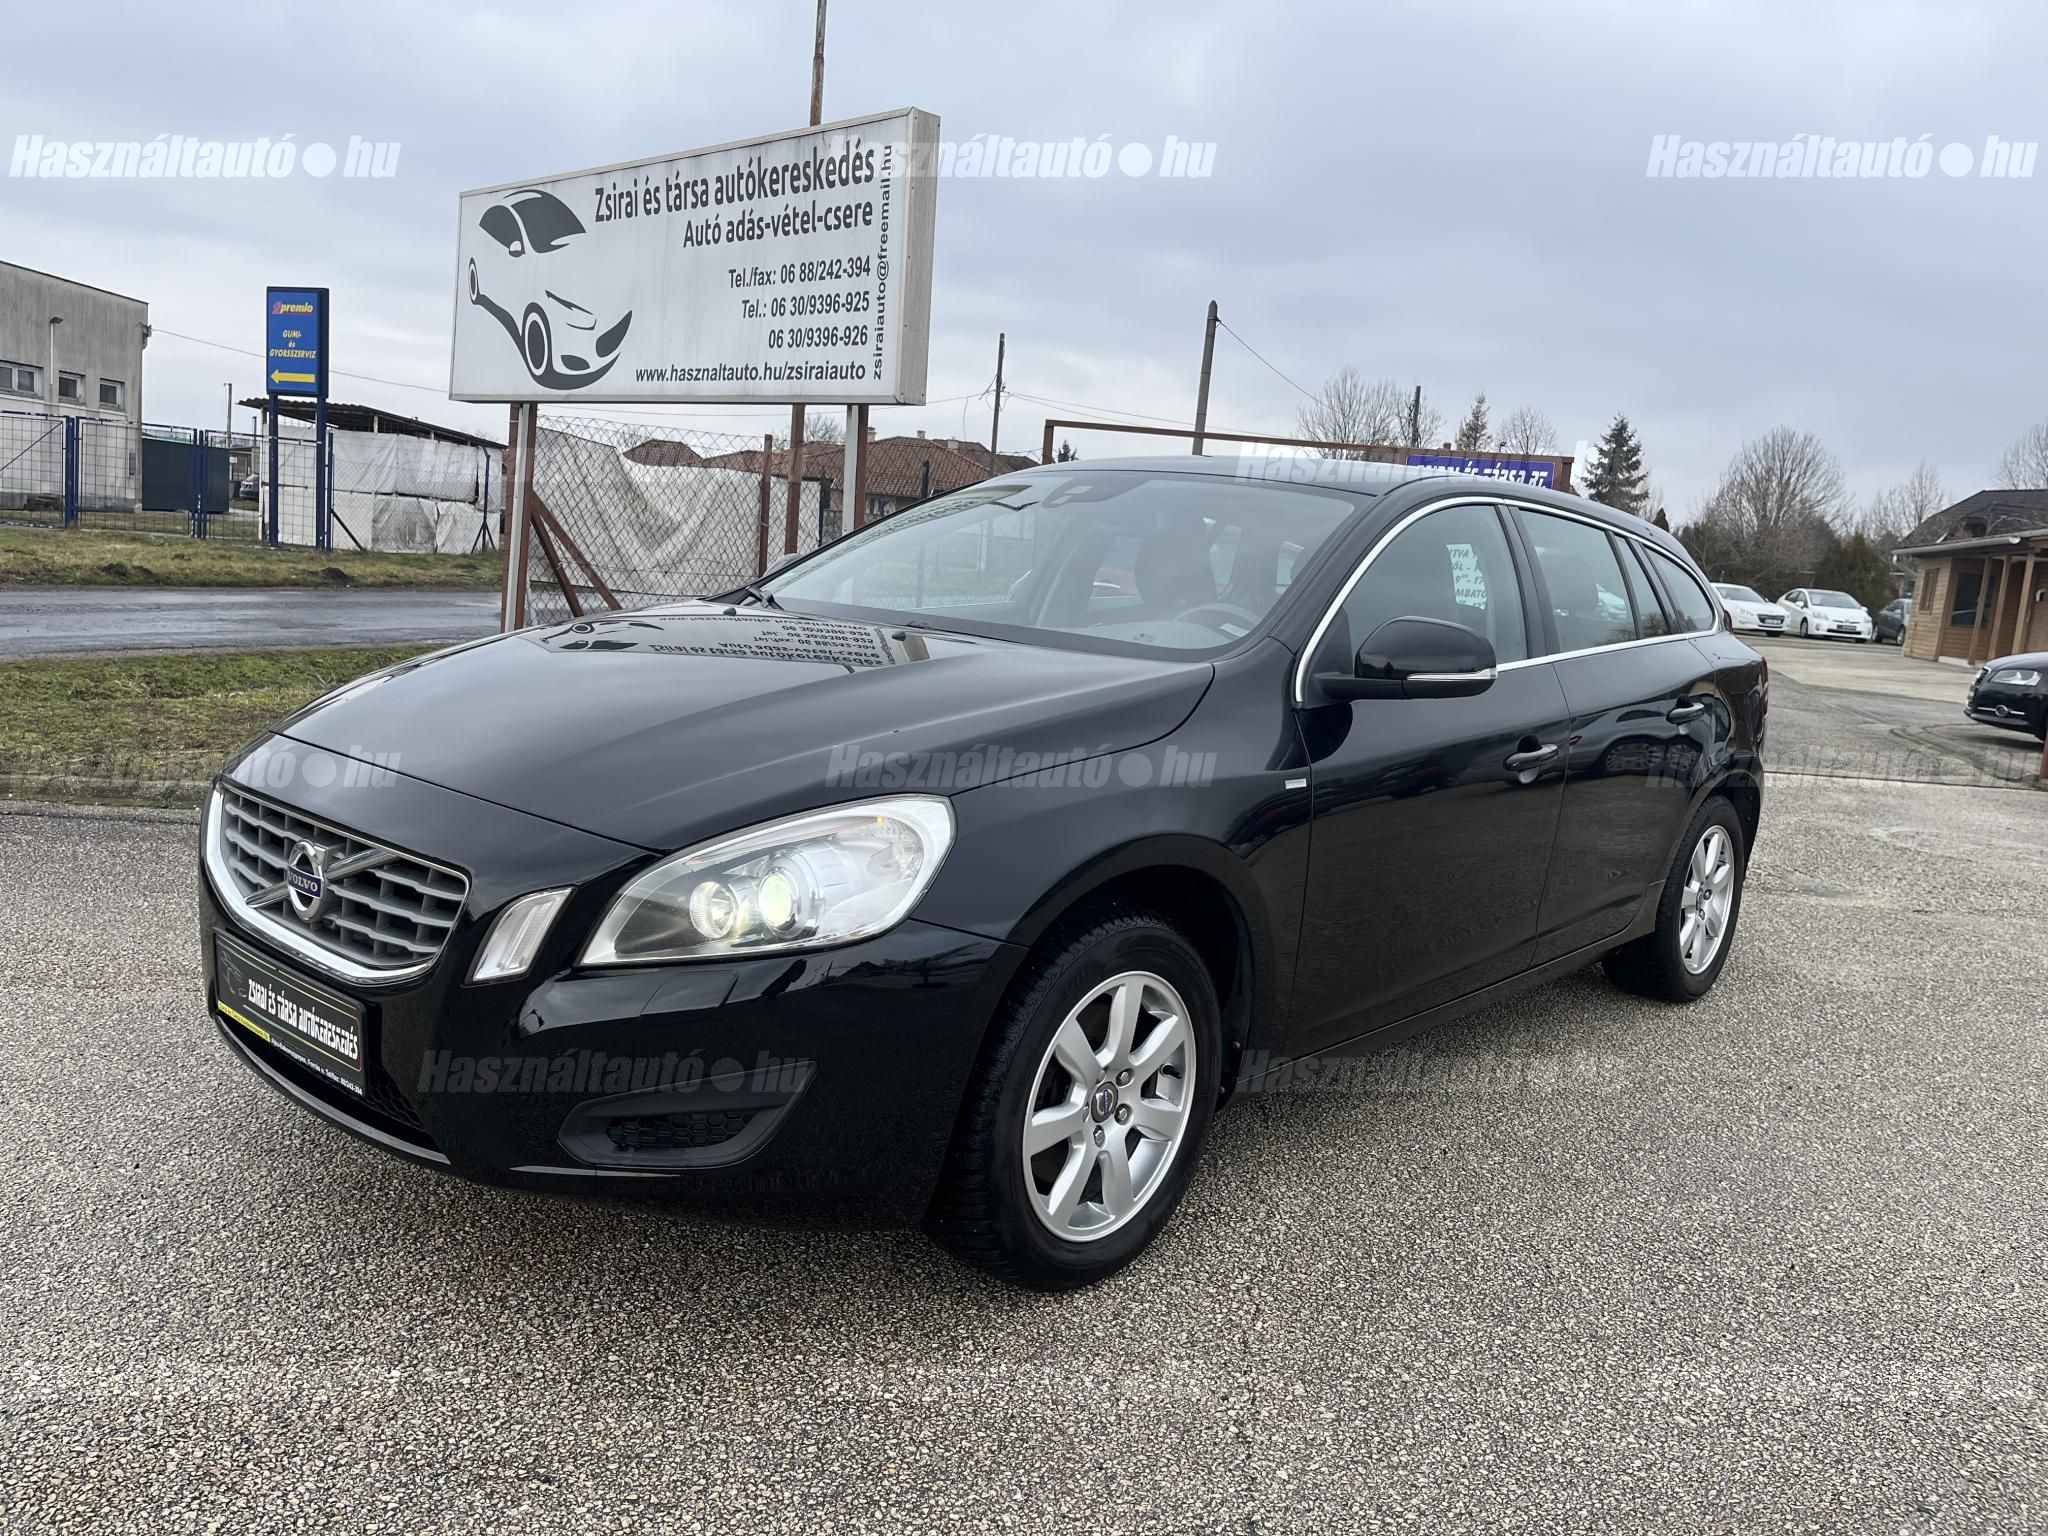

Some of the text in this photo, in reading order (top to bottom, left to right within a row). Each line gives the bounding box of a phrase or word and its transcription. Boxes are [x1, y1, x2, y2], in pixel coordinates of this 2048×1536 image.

[595, 138, 875, 222] Zsirai és társa autókereskedés
[683, 199, 874, 248] Autó adás-vétel-csere
[728, 255, 871, 289] Tel./fax: 06 88/242-394
[873, 144, 893, 381] zsiraiauto@freemail.hu
[742, 290, 870, 319] Tel.: 06 30/9396-925
[768, 324, 868, 349] 06 30/9396-926
[269, 348, 317, 359] GYORSSZERVIZ
[635, 360, 867, 382] www.hasznaltauto.hu/zsiraiauto
[287, 871, 319, 893] VOLVO
